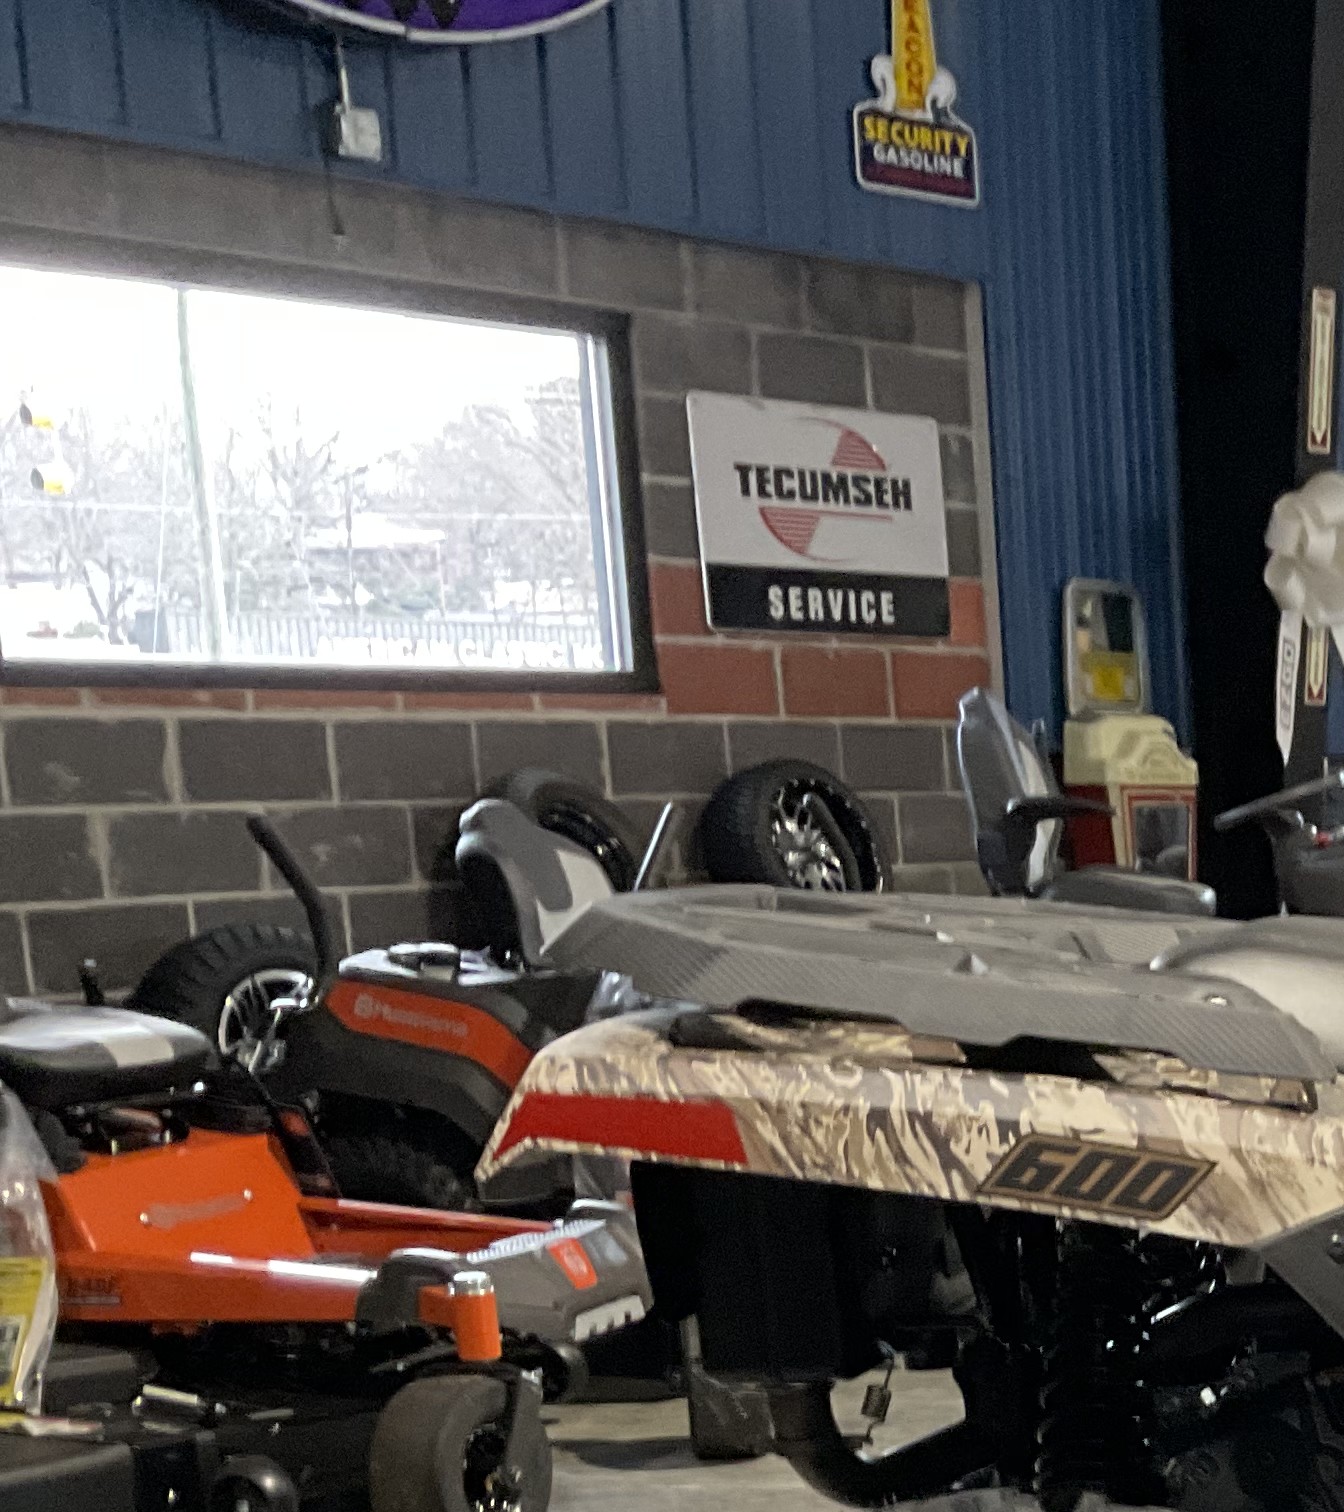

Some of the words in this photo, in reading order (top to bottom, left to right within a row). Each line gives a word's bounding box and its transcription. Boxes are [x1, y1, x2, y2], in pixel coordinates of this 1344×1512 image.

[864, 115, 969, 158] SECURITY
[873, 143, 965, 179] GASOLINE
[733, 461, 913, 511] TECUMSEH
[768, 585, 895, 624] SERVICE
[994, 1138, 1201, 1212] 600
